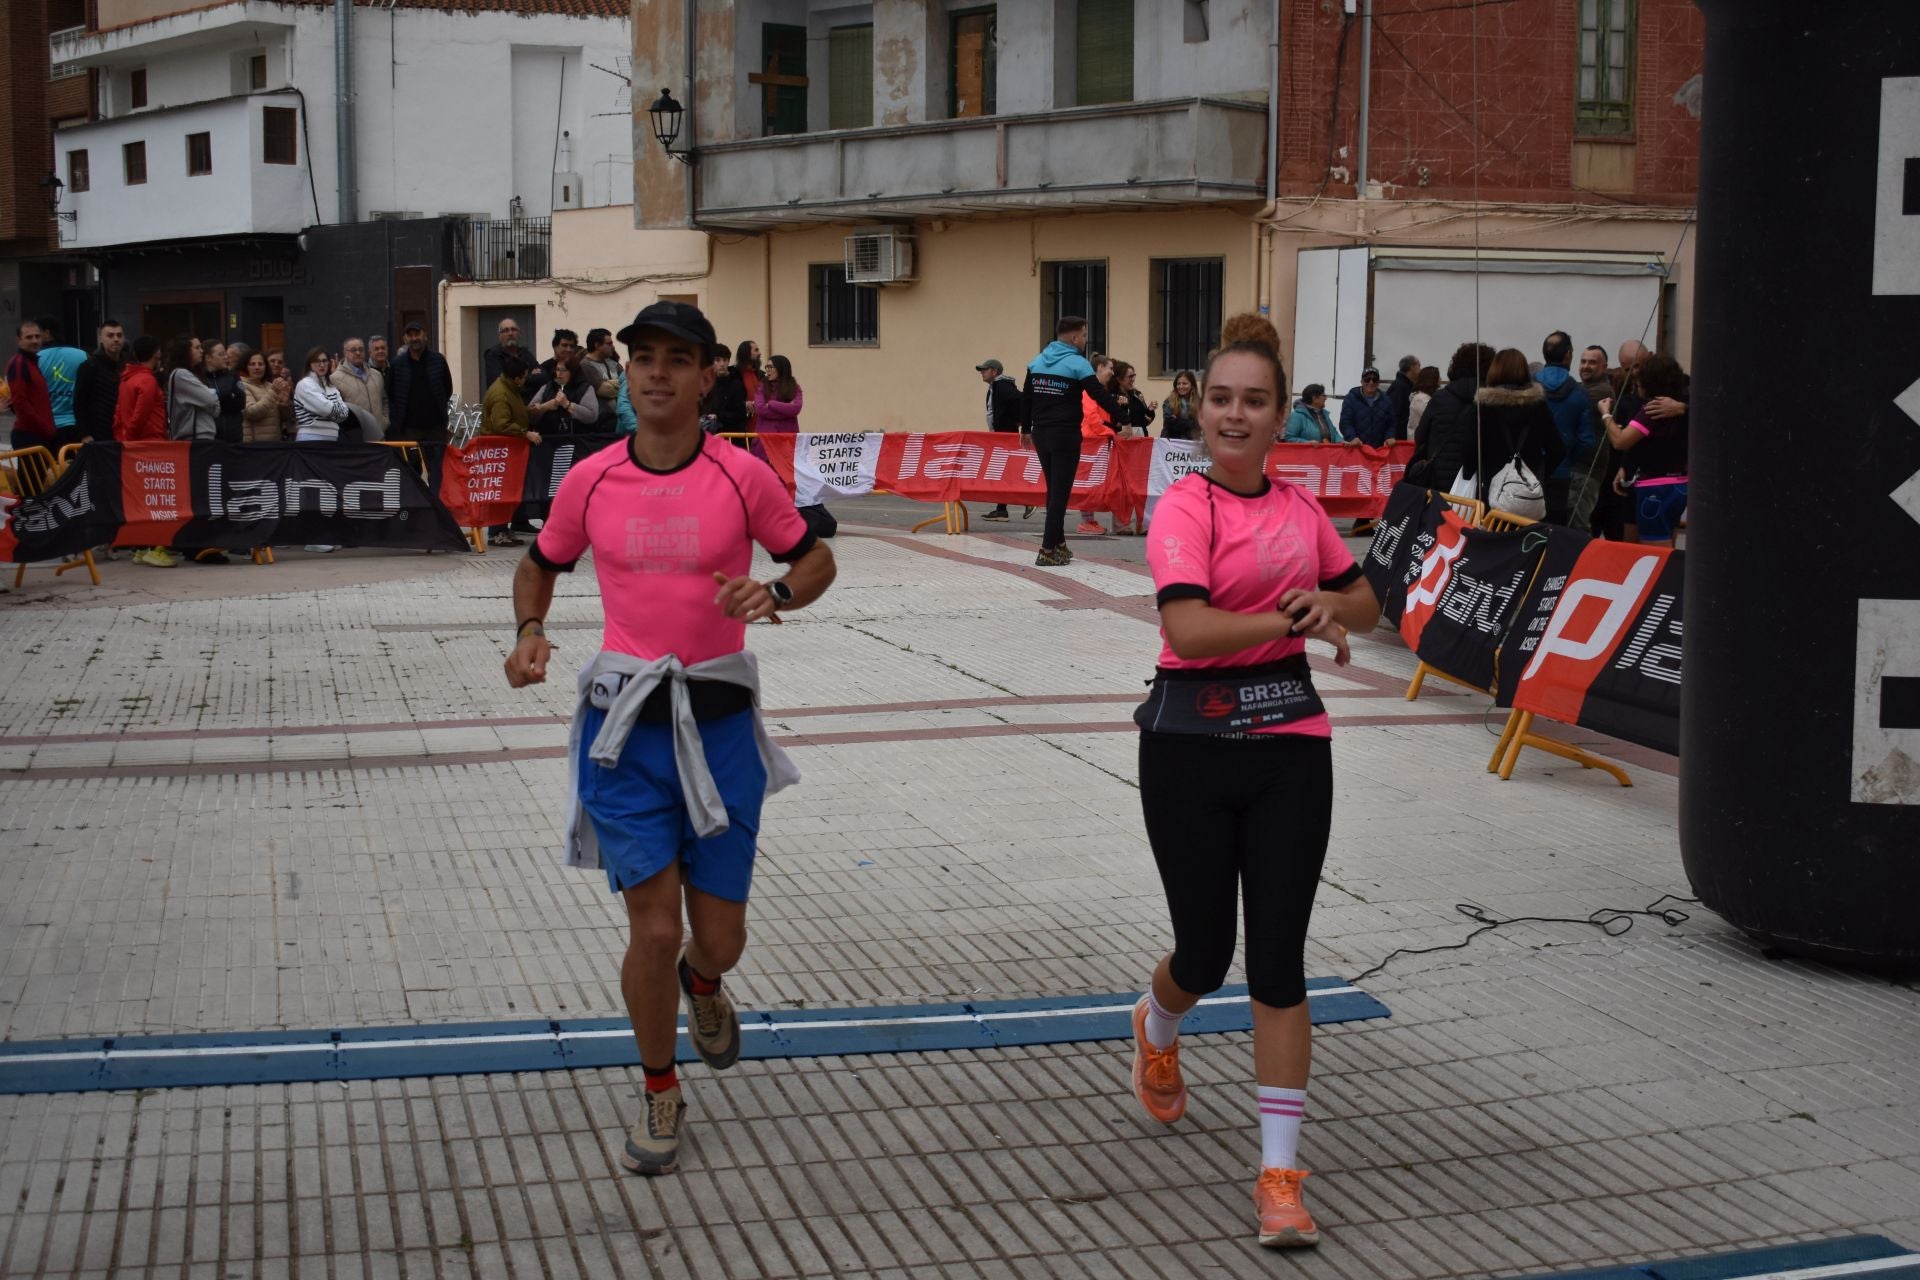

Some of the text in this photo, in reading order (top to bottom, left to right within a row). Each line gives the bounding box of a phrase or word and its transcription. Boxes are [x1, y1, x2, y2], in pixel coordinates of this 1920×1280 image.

[810, 433, 866, 446] CHANGES
[818, 447, 862, 460] STARTS
[135, 461, 175, 474] CHANGES
[819, 461, 859, 474] ON THE
[143, 477, 176, 490] STARTS
[482, 476, 503, 488] THE
[824, 475, 858, 487] INSIDE
[208, 463, 401, 521] land
[470, 490, 501, 502] INSIDE
[145, 494, 176, 506] ON THE
[150, 510, 178, 521] INSIDE
[1239, 679, 1305, 703] GR322
